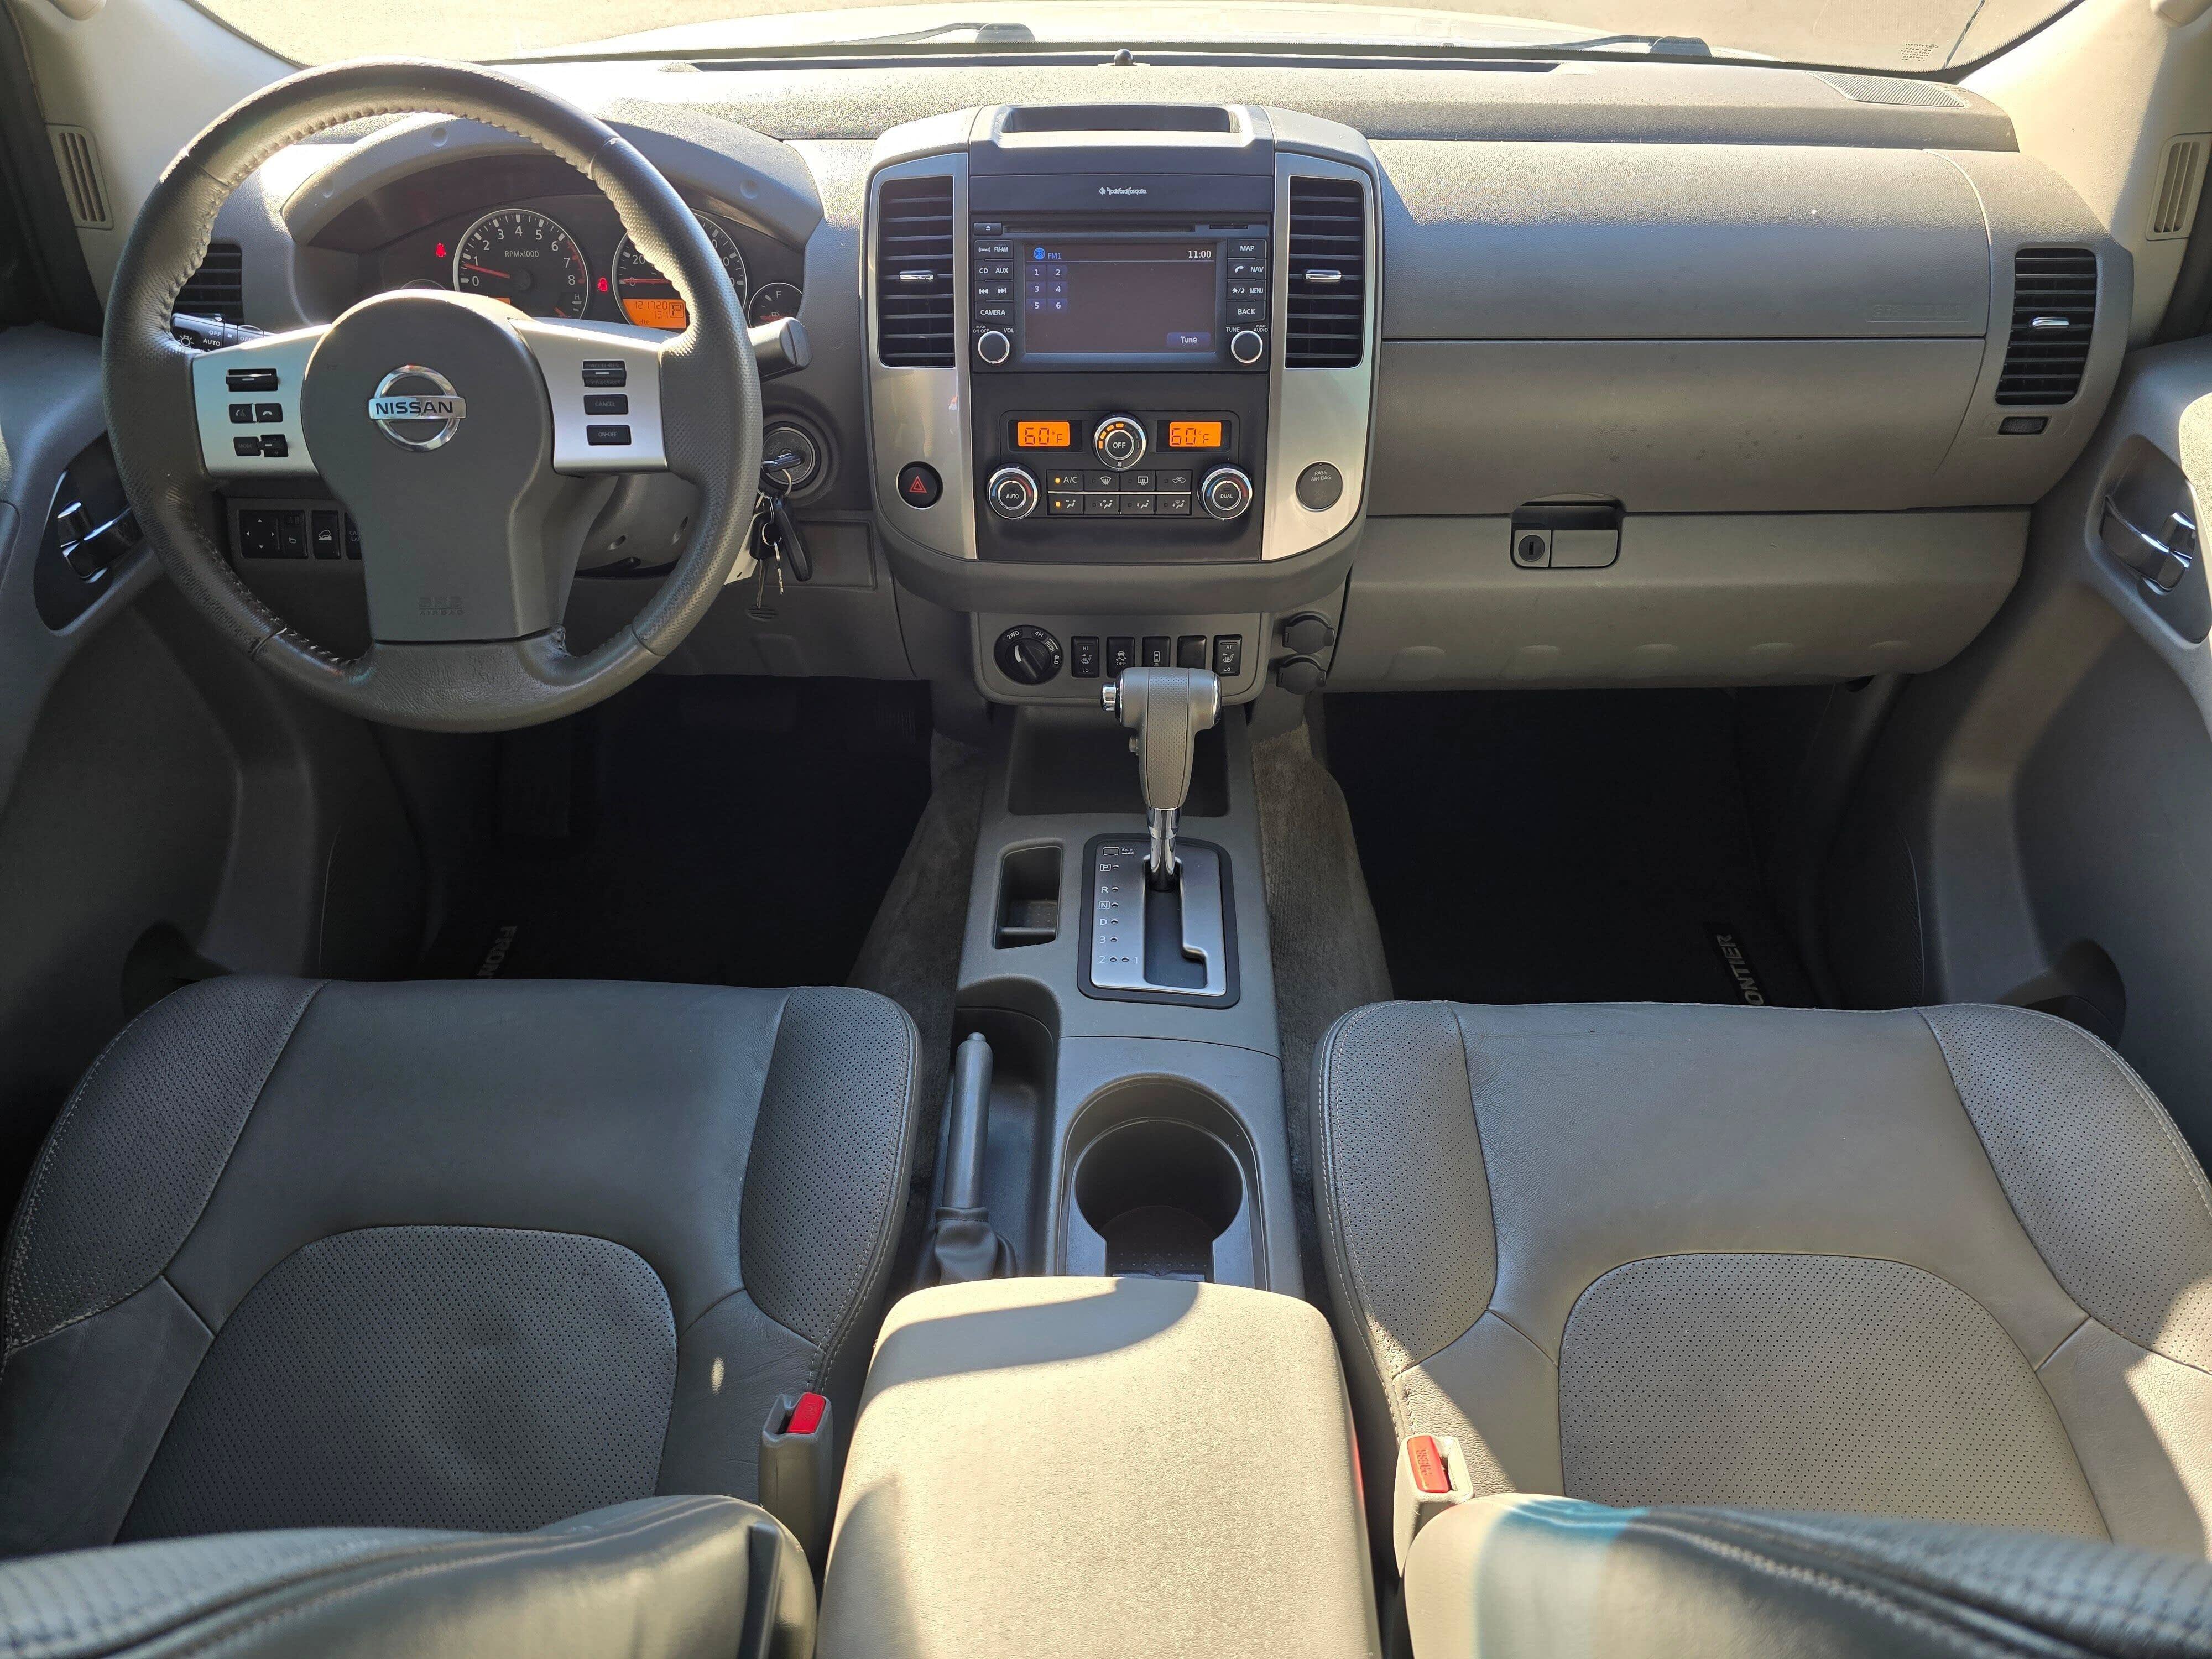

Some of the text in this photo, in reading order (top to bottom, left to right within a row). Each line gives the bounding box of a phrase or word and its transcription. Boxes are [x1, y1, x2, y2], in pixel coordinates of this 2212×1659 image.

[497, 229, 504, 239] 3
[515, 226, 523, 236] 4
[535, 230, 542, 240] 5
[483, 240, 490, 251] 2
[551, 241, 559, 251] 6
[474, 256, 478, 265] 1
[563, 257, 570, 268] 7
[632, 254, 645, 264] 20
[472, 276, 479, 286] 0
[568, 275, 576, 285] 8
[776, 290, 781, 299] F
[672, 304, 682, 316] P
[375, 401, 453, 414] NISSAN
[1006, 630, 1019, 639] 2WD
[1045, 640, 1055, 653] PUSH
